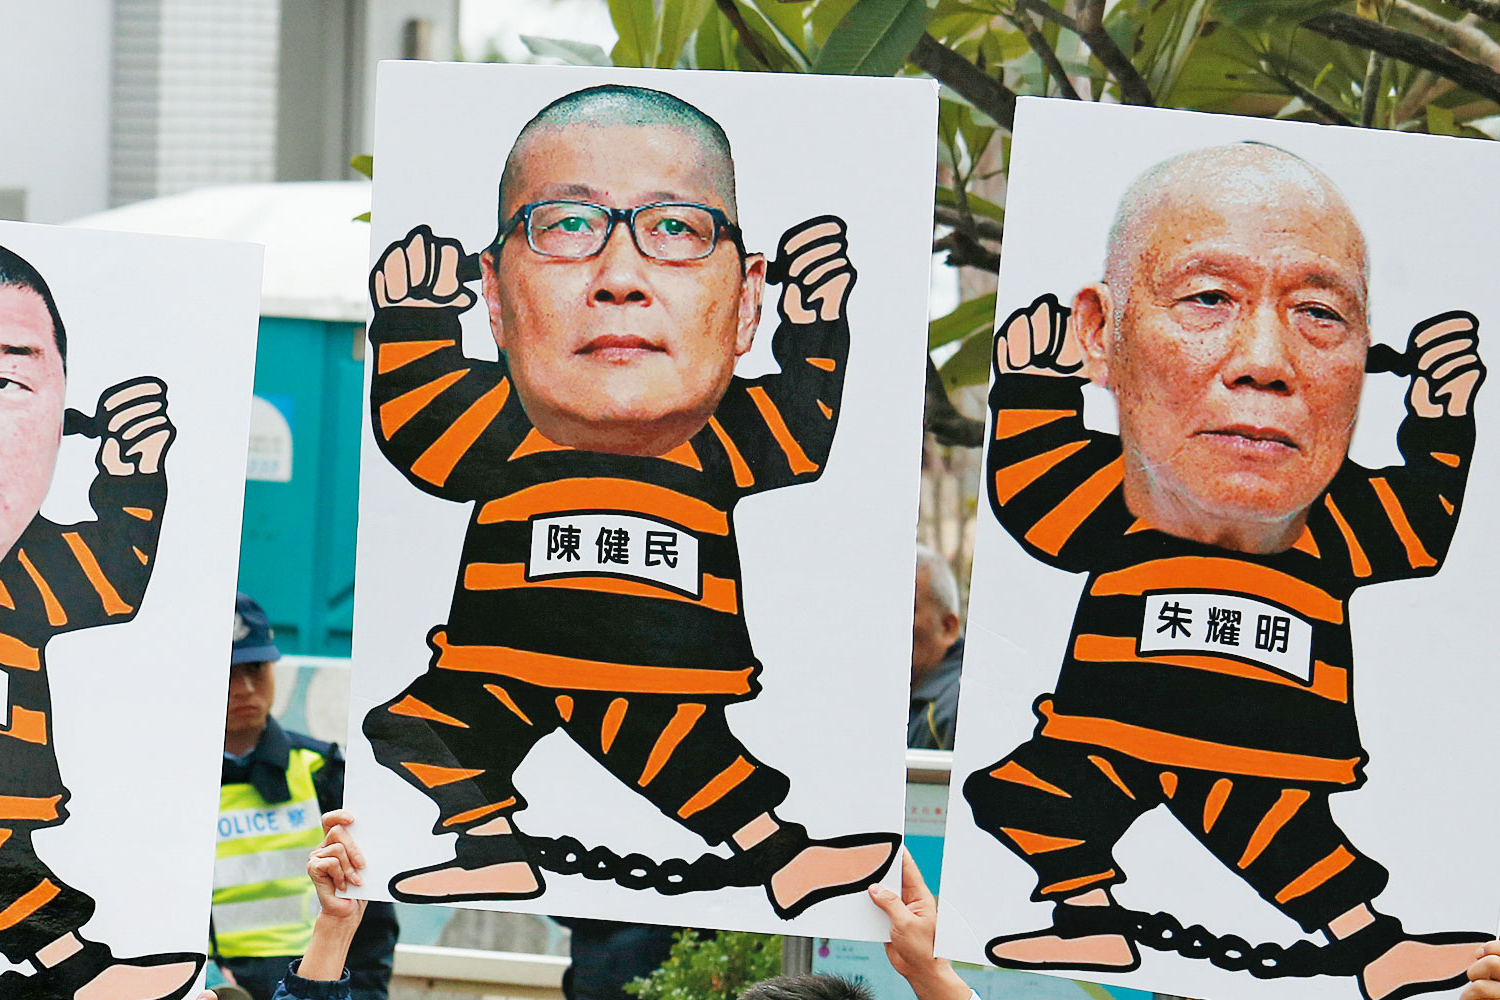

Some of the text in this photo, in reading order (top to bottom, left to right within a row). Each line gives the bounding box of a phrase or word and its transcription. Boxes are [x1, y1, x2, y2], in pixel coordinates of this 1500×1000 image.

[547, 524, 679, 568] 陳健民
[1156, 601, 1291, 653] 朱耀明
[218, 811, 279, 837] OLICE
